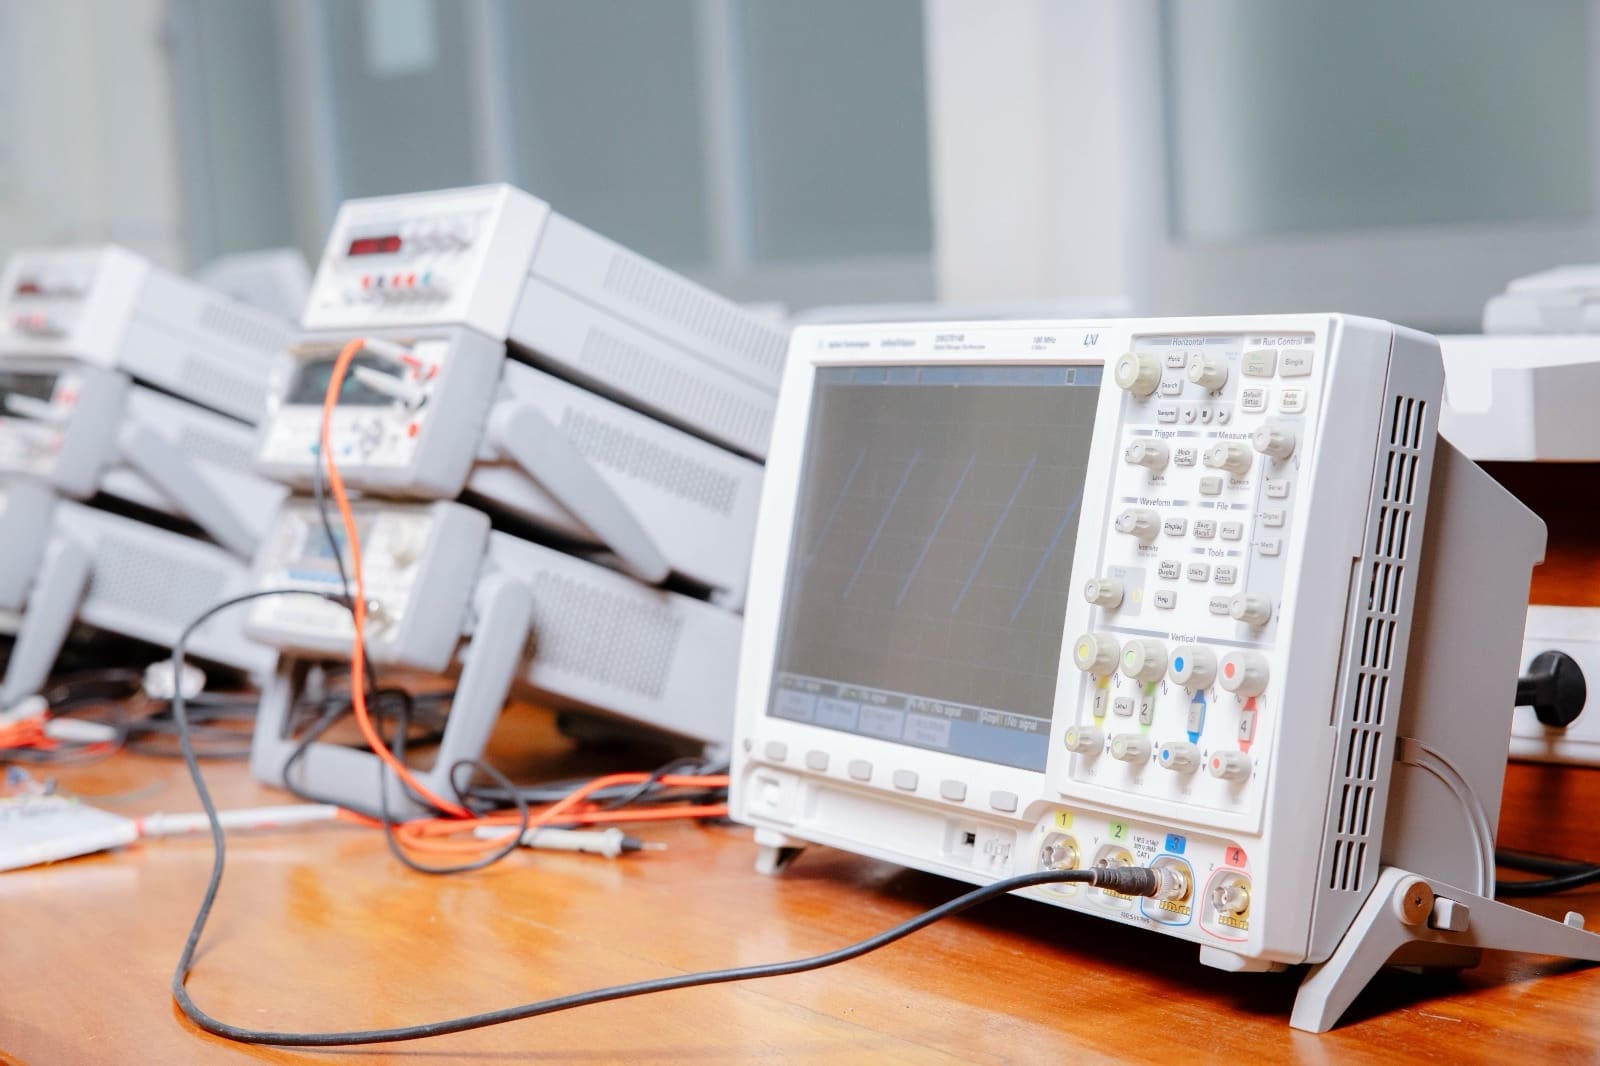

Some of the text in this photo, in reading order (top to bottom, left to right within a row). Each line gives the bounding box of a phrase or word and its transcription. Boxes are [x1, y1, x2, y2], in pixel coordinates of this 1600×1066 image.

[1171, 337, 1206, 346] Horizontal
[1262, 337, 1303, 346] Run Control
[1152, 429, 1176, 440] Trigger
[1217, 431, 1247, 440] Measure
[1139, 497, 1171, 508] Waveform
[1216, 501, 1229, 511] File
[1262, 512, 1280, 522] Digital
[1164, 522, 1182, 532] Display
[1196, 521, 1210, 529] Save
[1207, 547, 1225, 558] Tools
[1157, 568, 1176, 577] Display
[1171, 632, 1196, 643] Vertical
[1095, 696, 1102, 708] 1
[1141, 703, 1149, 716] 2
[1240, 719, 1248, 732] 4
[1060, 813, 1068, 826] 1
[1114, 825, 1123, 838] 2
[1171, 836, 1180, 851] 3
[1136, 850, 1147, 858] CAT
[1231, 851, 1240, 864] 4
